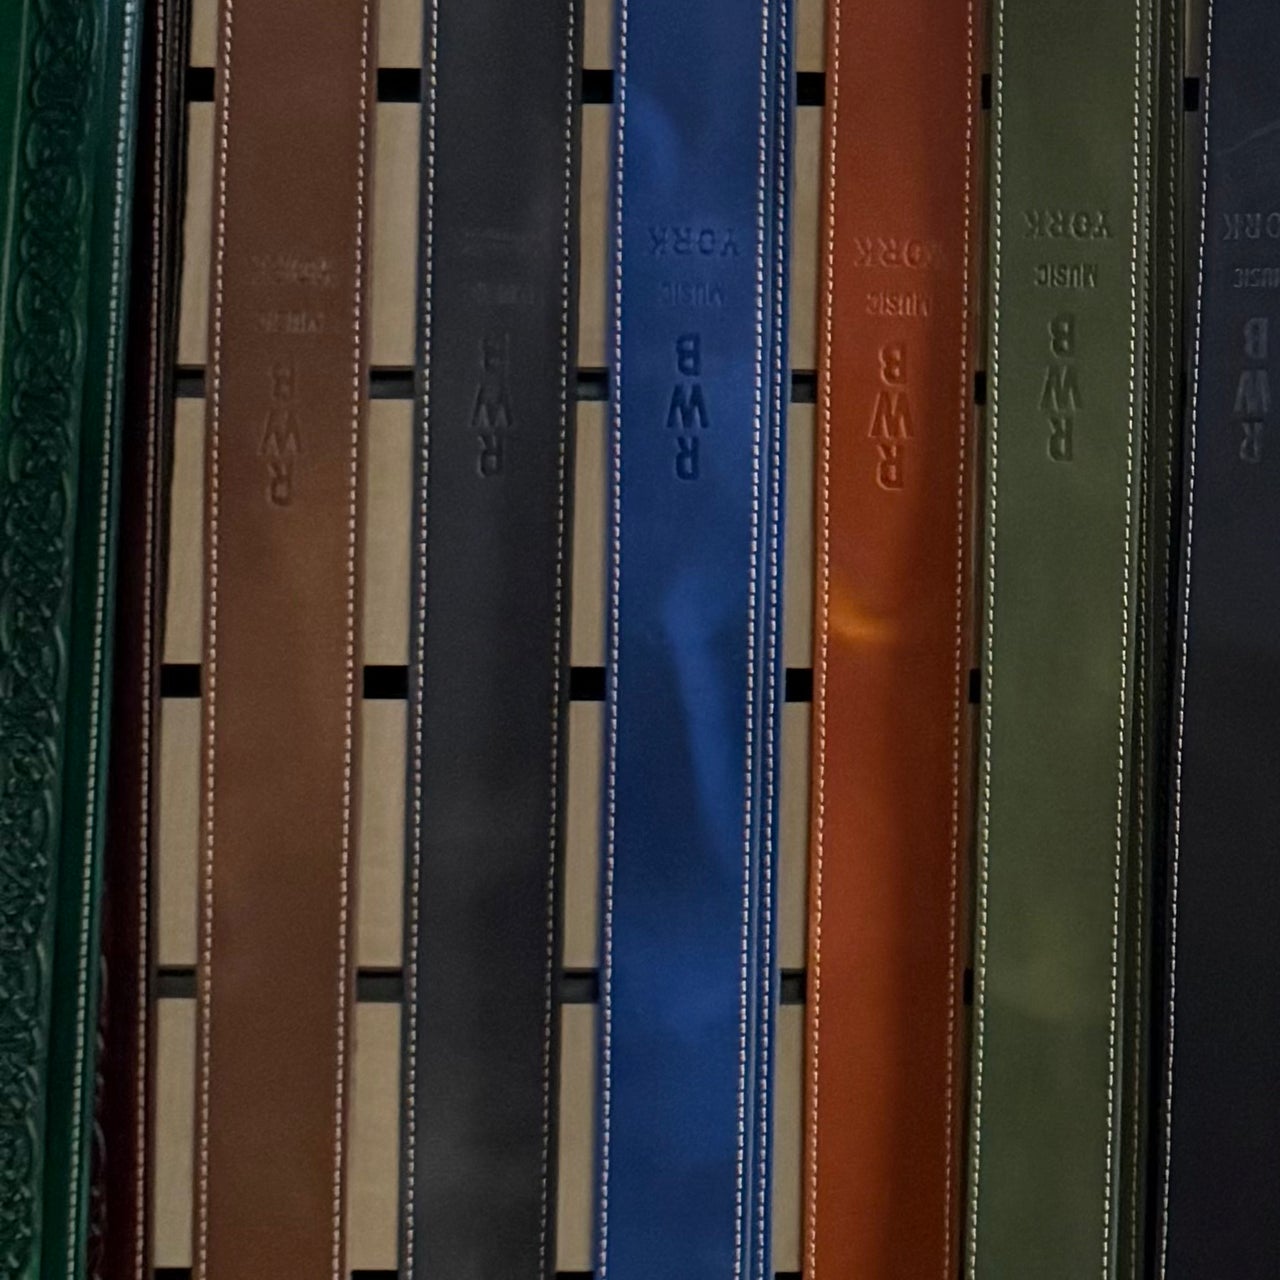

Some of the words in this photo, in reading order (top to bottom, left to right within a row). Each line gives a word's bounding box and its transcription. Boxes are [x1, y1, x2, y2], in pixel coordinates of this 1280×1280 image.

[1023, 211, 1115, 241] YORK
[647, 226, 742, 258] YORK
[1033, 263, 1099, 288] MUSIC
